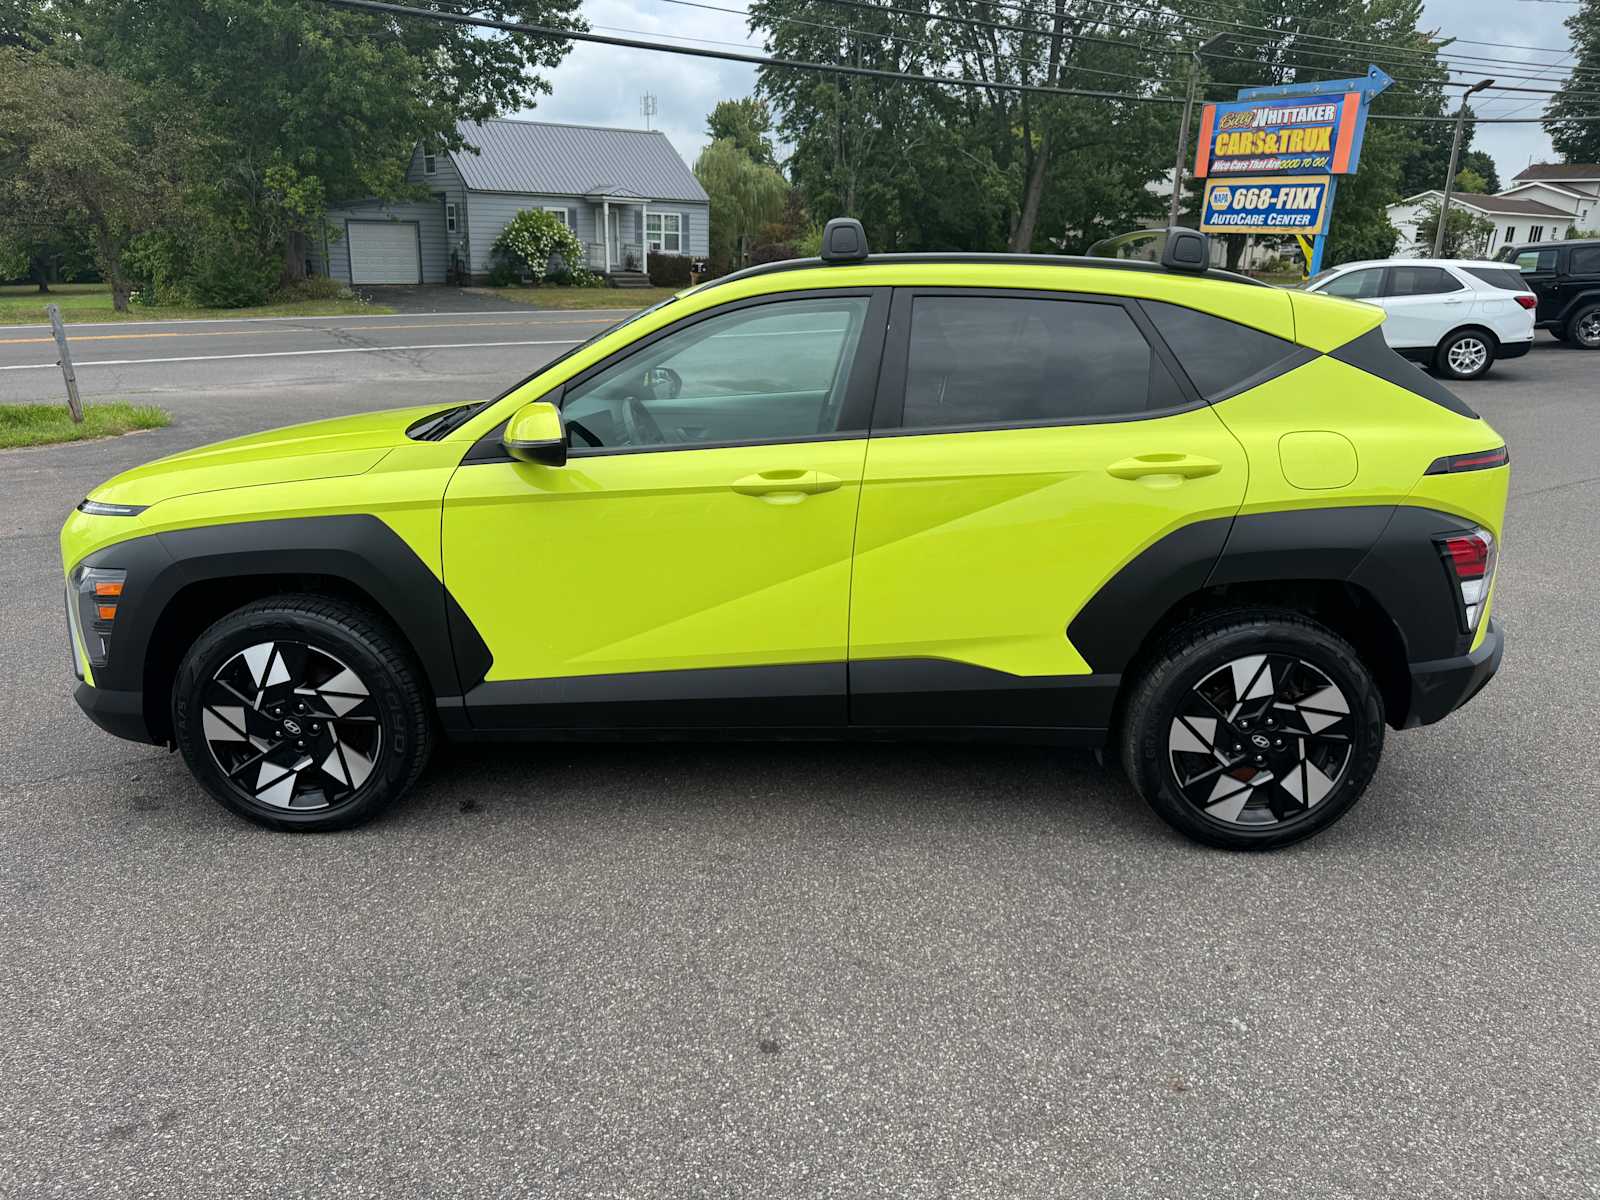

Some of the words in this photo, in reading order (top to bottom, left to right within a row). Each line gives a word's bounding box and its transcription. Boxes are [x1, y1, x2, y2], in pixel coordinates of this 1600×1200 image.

[1220, 111, 1254, 129] Billy
[1252, 105, 1335, 127] WHITTAKER
[1212, 160, 1231, 170] Nice
[1231, 159, 1249, 170] Cars
[1249, 159, 1268, 169] That
[1267, 158, 1281, 169] Are
[1280, 159, 1300, 169] GOOD
[1301, 159, 1311, 168] TO
[1313, 157, 1328, 168] GO!
[1213, 192, 1229, 203] NAPA
[1232, 187, 1320, 210] 668-FIXX
